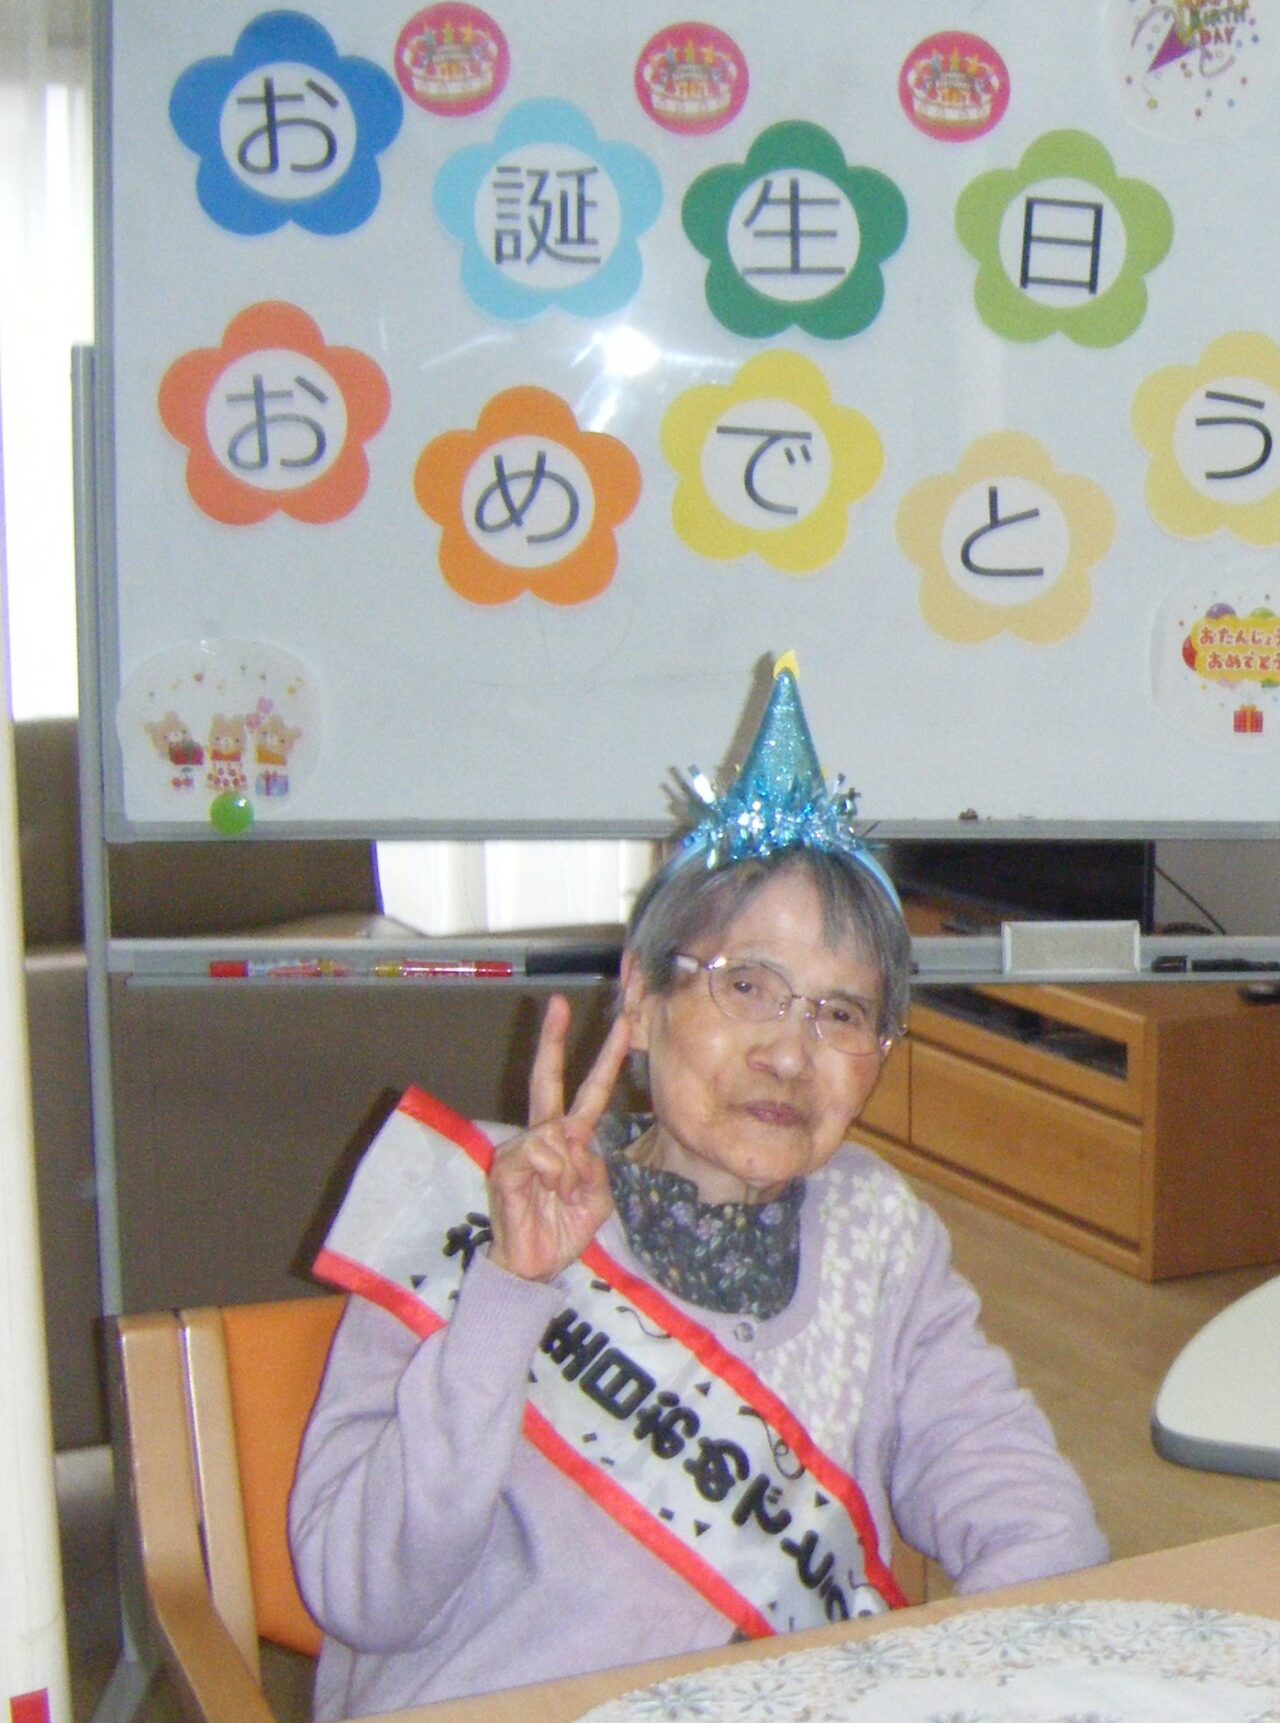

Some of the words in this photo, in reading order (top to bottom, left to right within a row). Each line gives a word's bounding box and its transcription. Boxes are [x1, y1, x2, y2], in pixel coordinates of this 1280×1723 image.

[1200, 25, 1235, 46] DAY
[236, 77, 1104, 295] お誕生日
[225, 374, 1272, 578] おめでとう
